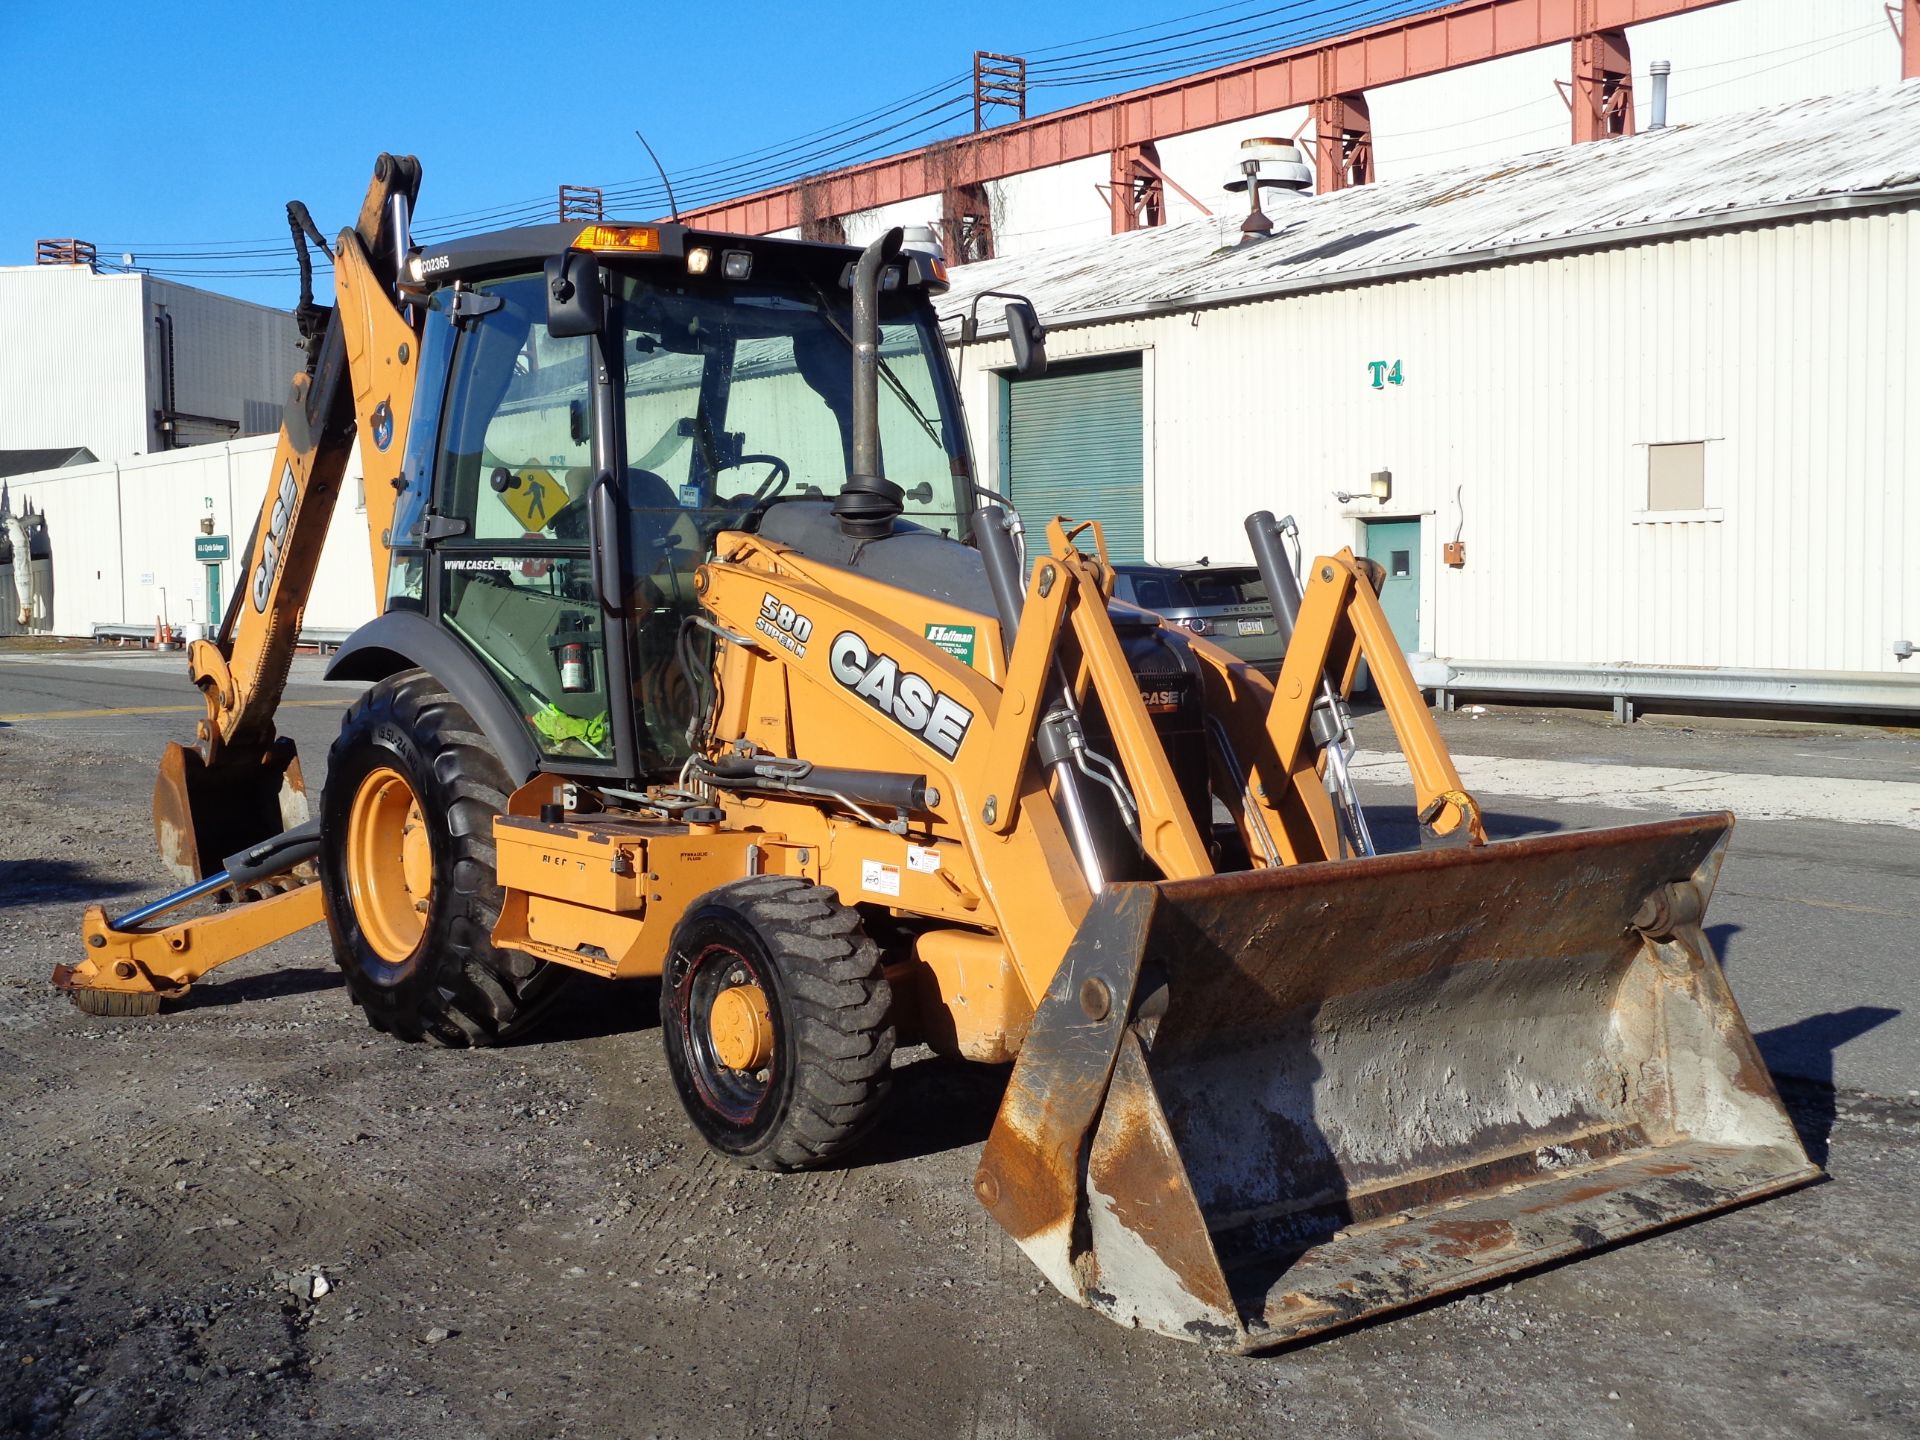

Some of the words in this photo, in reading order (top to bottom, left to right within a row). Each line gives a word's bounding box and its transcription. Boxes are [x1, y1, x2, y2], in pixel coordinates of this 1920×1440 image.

[1367, 359, 1404, 390] T4
[204, 496, 214, 509] T2
[254, 458, 299, 614] CASE
[760, 592, 813, 643] 580
[1223, 604, 1272, 613] DISCOVER
[755, 616, 796, 652] SUPER
[794, 642, 806, 659] N
[927, 626, 973, 643] Hoffman
[829, 630, 974, 762] CASE
[1141, 690, 1179, 705] CASE
